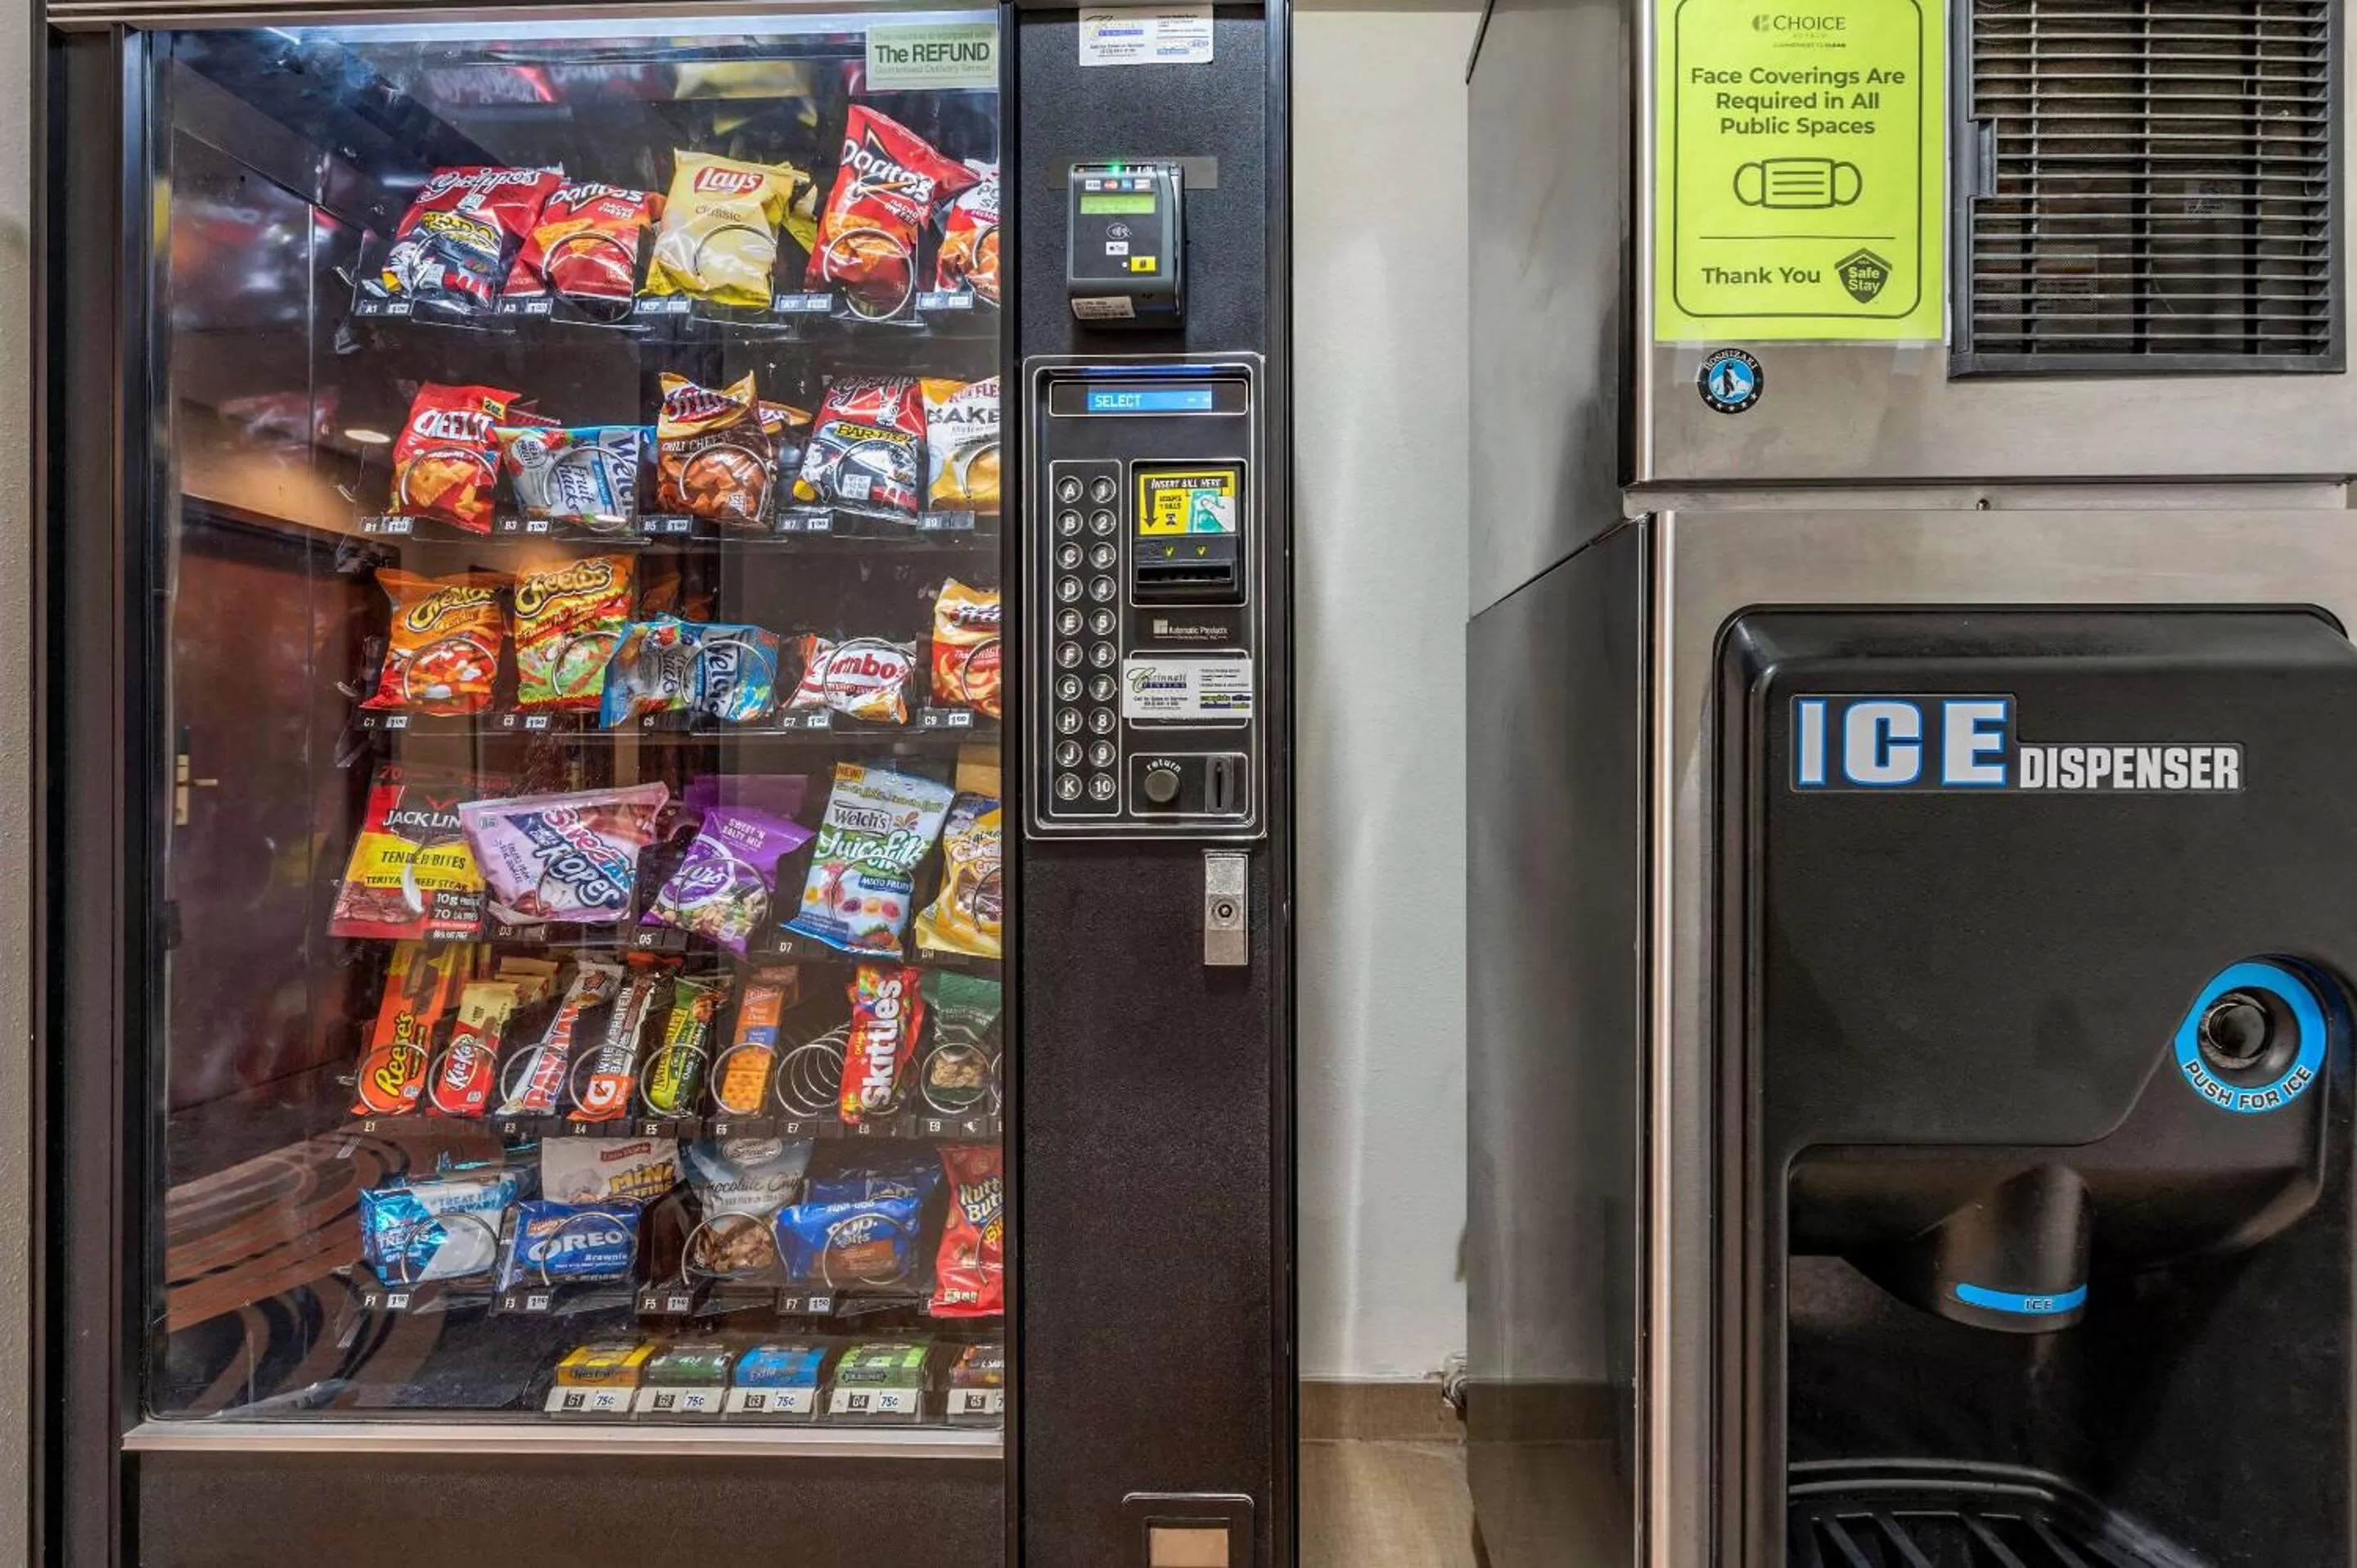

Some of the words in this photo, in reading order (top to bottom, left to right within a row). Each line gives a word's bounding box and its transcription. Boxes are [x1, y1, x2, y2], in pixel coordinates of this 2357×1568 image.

[1773, 15, 1846, 30] CHOICE
[875, 45, 908, 63] The
[913, 43, 990, 62] REFUND
[1692, 68, 1742, 84] Face
[1750, 66, 1860, 88] Coverings
[1867, 68, 1905, 84] Are
[1716, 92, 1817, 113] Required
[1825, 92, 1844, 109] in
[1851, 92, 1880, 109] All
[1721, 117, 1790, 135] Public
[1796, 118, 1876, 137] Spaces
[1702, 267, 1773, 285] Thank
[1779, 267, 1821, 285] You
[1848, 266, 1880, 279] Safe
[1848, 279, 1881, 293] Stay
[502, 303, 516, 313] A3
[949, 382, 1000, 403] RUFFLE
[1095, 394, 1143, 408] SELECT
[926, 406, 1001, 425] BAKE
[1065, 484, 1075, 496] A
[1099, 484, 1106, 495] 1
[1151, 478, 1179, 490] INSERT
[364, 522, 377, 533] B1
[504, 520, 517, 531] B3
[644, 520, 656, 530] B5
[783, 520, 796, 530] B7
[1065, 516, 1075, 529] B
[1097, 516, 1107, 529] 2
[1065, 549, 1076, 563] C
[1097, 550, 1107, 563] 3
[515, 565, 609, 615] Cheetos
[1065, 582, 1075, 596] D
[1097, 582, 1107, 595] 4
[1065, 615, 1075, 628] E
[1098, 615, 1107, 628] 5
[1065, 648, 1075, 660] F
[1097, 648, 1107, 660] 6
[1065, 681, 1076, 694] G
[1097, 681, 1107, 694] 7
[363, 718, 376, 727] C1
[783, 718, 796, 727] C7
[925, 716, 938, 726] C9
[1065, 714, 1075, 727] H
[1097, 714, 1107, 727] 8
[1799, 700, 2008, 786] ICE
[2019, 746, 2239, 790] DISPENSER
[1066, 747, 1075, 760] J
[1097, 747, 1107, 759] 9
[1146, 758, 1182, 773] return
[1065, 780, 1075, 793] K
[1095, 780, 1111, 793] 10
[383, 810, 430, 827] JACK
[431, 812, 462, 829] LIN
[835, 809, 887, 830] Welch's
[728, 818, 756, 835] SWEET
[433, 854, 466, 868] BITES
[366, 876, 402, 885] TERIYA
[435, 908, 451, 920] 70
[499, 926, 512, 936] D3
[639, 933, 652, 945] D5
[779, 942, 793, 953] D7
[608, 987, 633, 1039] PROTEIN
[861, 979, 903, 1109] Skittles
[374, 1010, 415, 1098] Reese's
[2184, 1061, 2234, 1106] PUSH
[2238, 1090, 2280, 1110] FOR
[2283, 1066, 2314, 1096] ICE
[588, 1079, 617, 1106] G
[365, 1122, 376, 1133] E1
[504, 1122, 516, 1133] E3
[575, 1124, 586, 1134] E4
[646, 1124, 658, 1135] E5
[716, 1124, 728, 1135] E6
[787, 1123, 799, 1133] E7
[930, 1121, 941, 1132] E9
[959, 1177, 1000, 1206] Nutt
[440, 1200, 498, 1214] FORWAR
[528, 1230, 624, 1261] OREO
[585, 1253, 628, 1261] Brownie
[365, 1295, 376, 1307] F1
[505, 1297, 516, 1309] F3
[644, 1299, 656, 1309] F5
[786, 1299, 798, 1309] F7
[2026, 1299, 2053, 1310] ICE
[568, 1394, 581, 1406] G1
